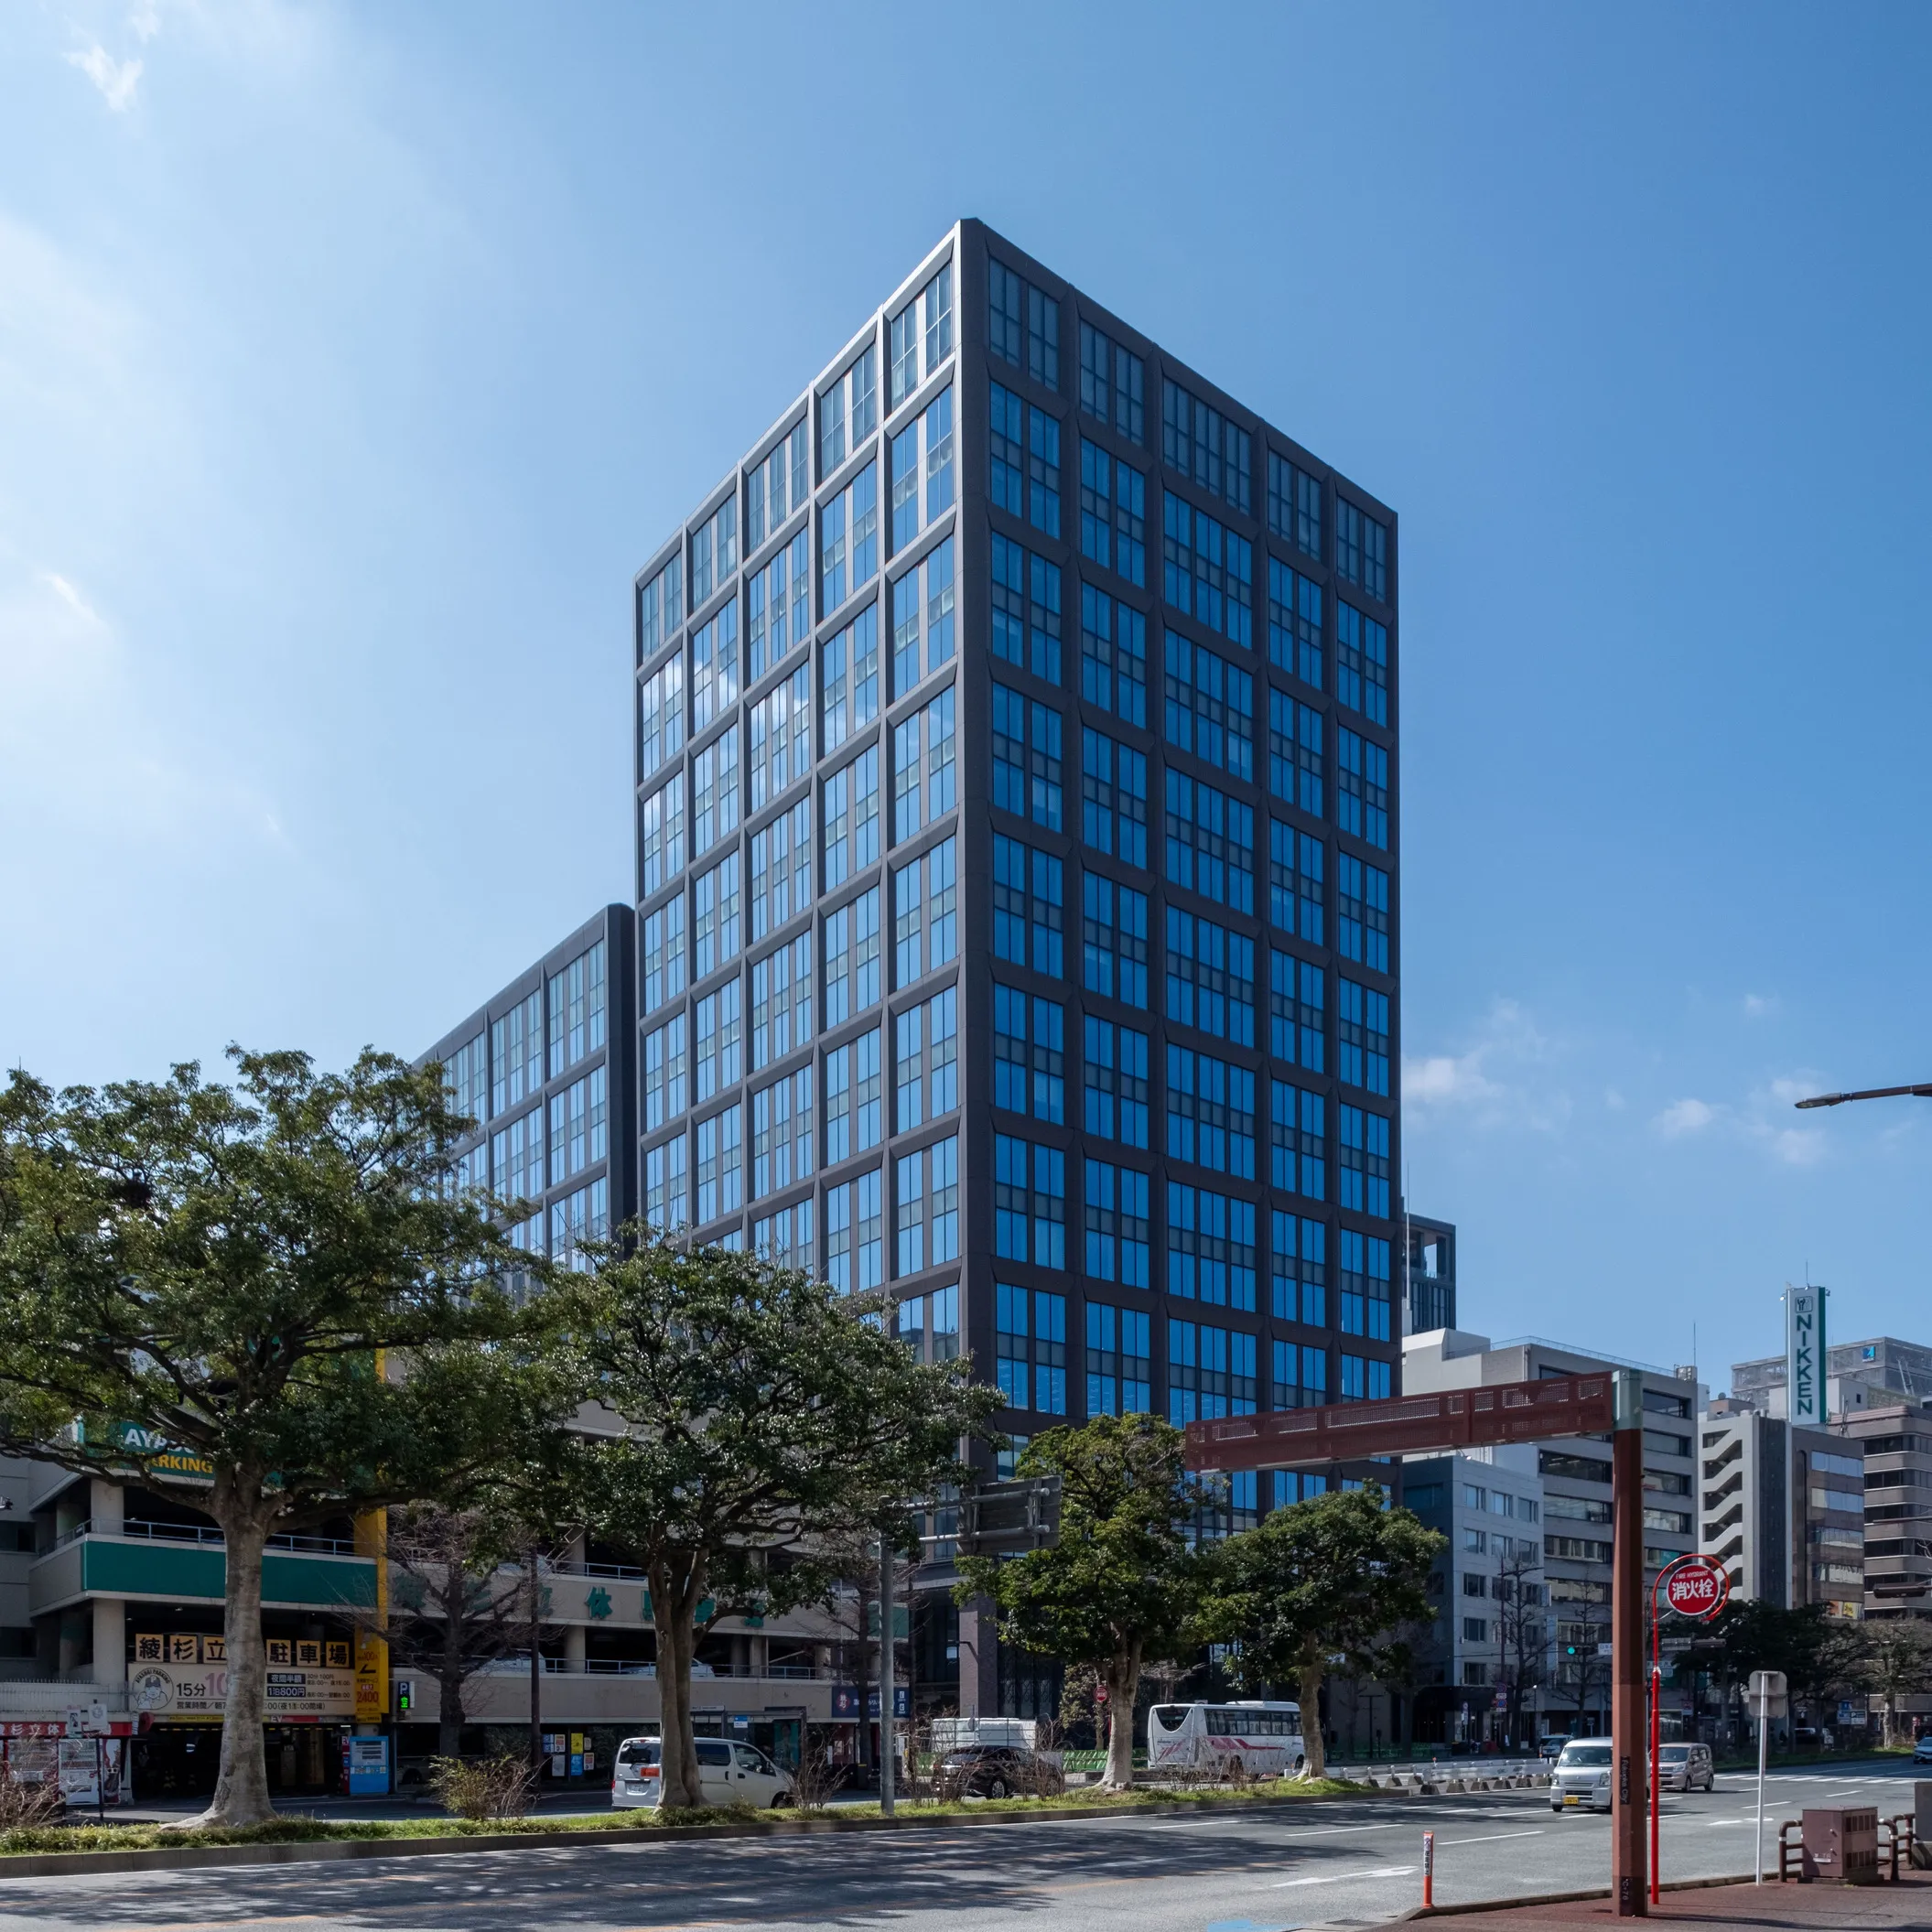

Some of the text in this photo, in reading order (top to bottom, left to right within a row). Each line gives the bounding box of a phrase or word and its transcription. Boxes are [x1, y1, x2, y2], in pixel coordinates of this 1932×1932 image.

[1797, 1313, 1813, 1416] NIKKEN
[1687, 1570, 1709, 1579] HYDRANT
[1671, 1578, 1714, 1601] 消火栓
[139, 1636, 347, 1665] 綾杉立駐車場
[177, 1683, 206, 1697] 15分
[400, 1682, 408, 1695] P
